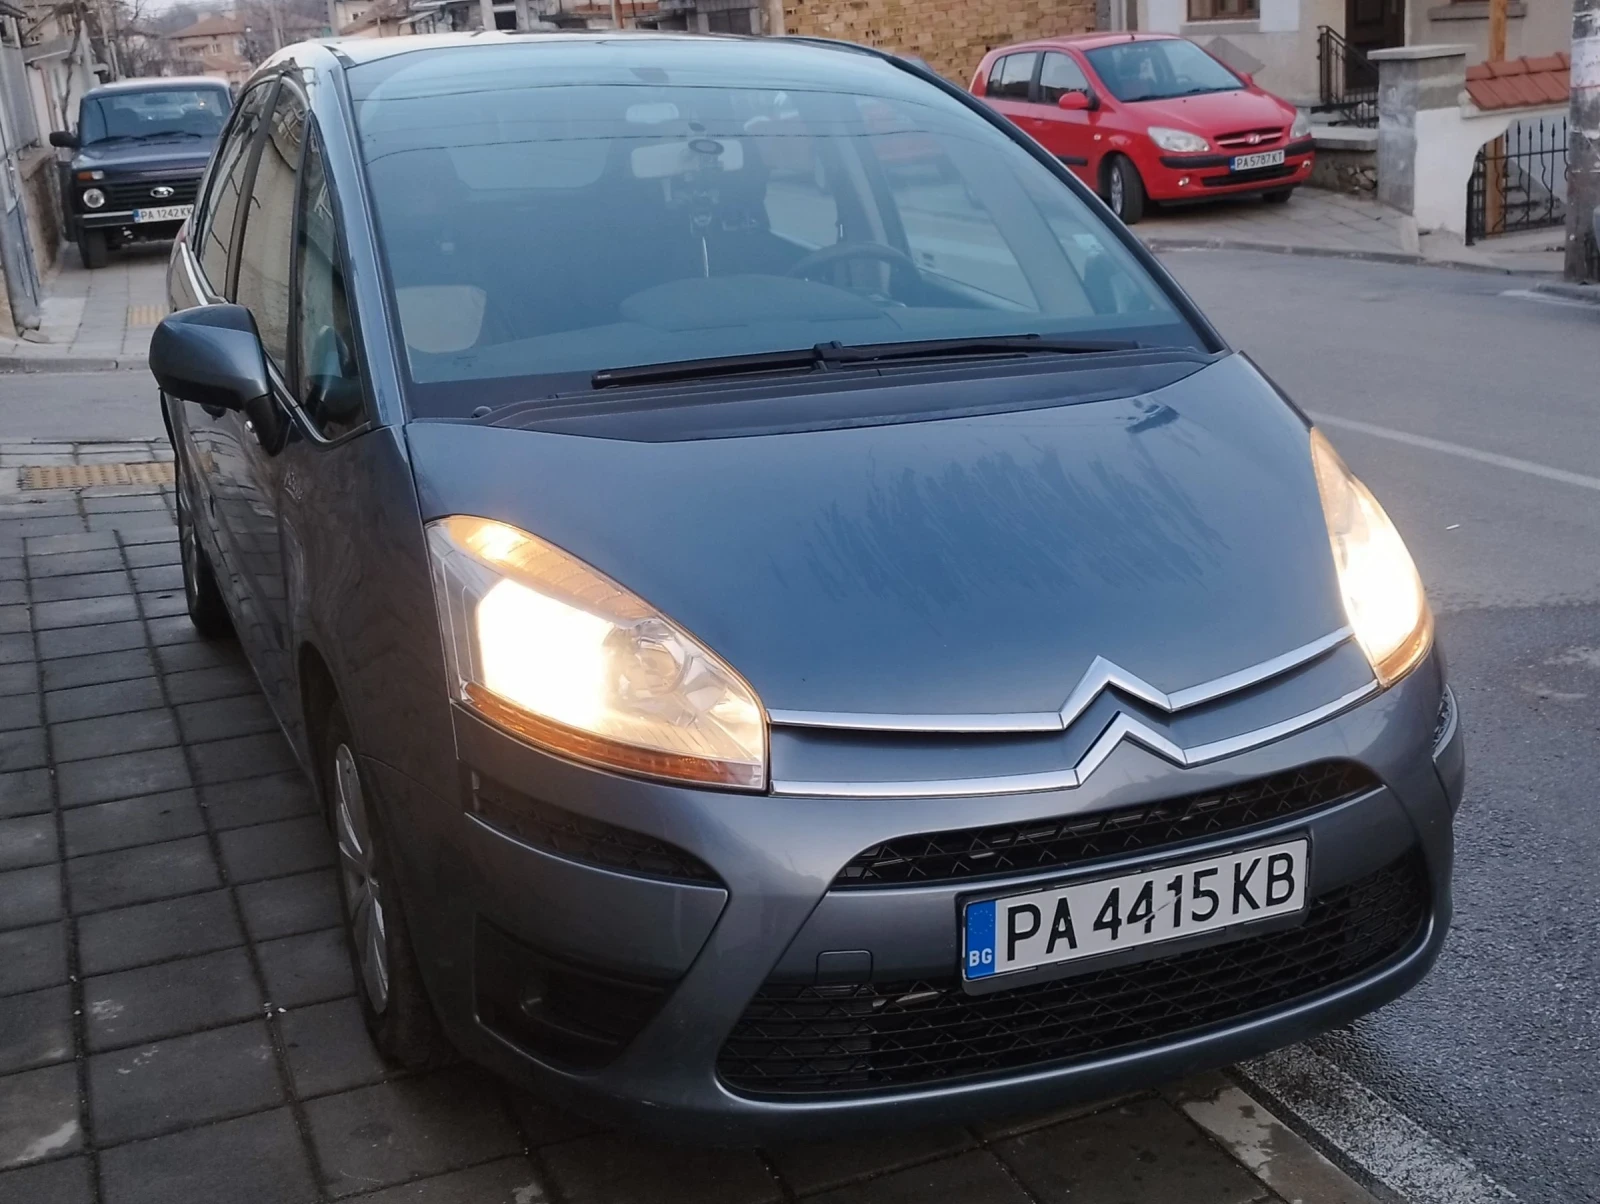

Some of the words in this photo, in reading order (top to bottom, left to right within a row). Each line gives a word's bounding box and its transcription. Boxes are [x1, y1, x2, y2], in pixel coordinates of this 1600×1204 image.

[1236, 157, 1249, 168] PA
[140, 210, 154, 220] PA
[157, 208, 179, 219] 1242
[1006, 897, 1078, 962] PA
[1093, 867, 1220, 941] 4415
[1232, 852, 1296, 914] KB
[968, 948, 993, 967] BG
